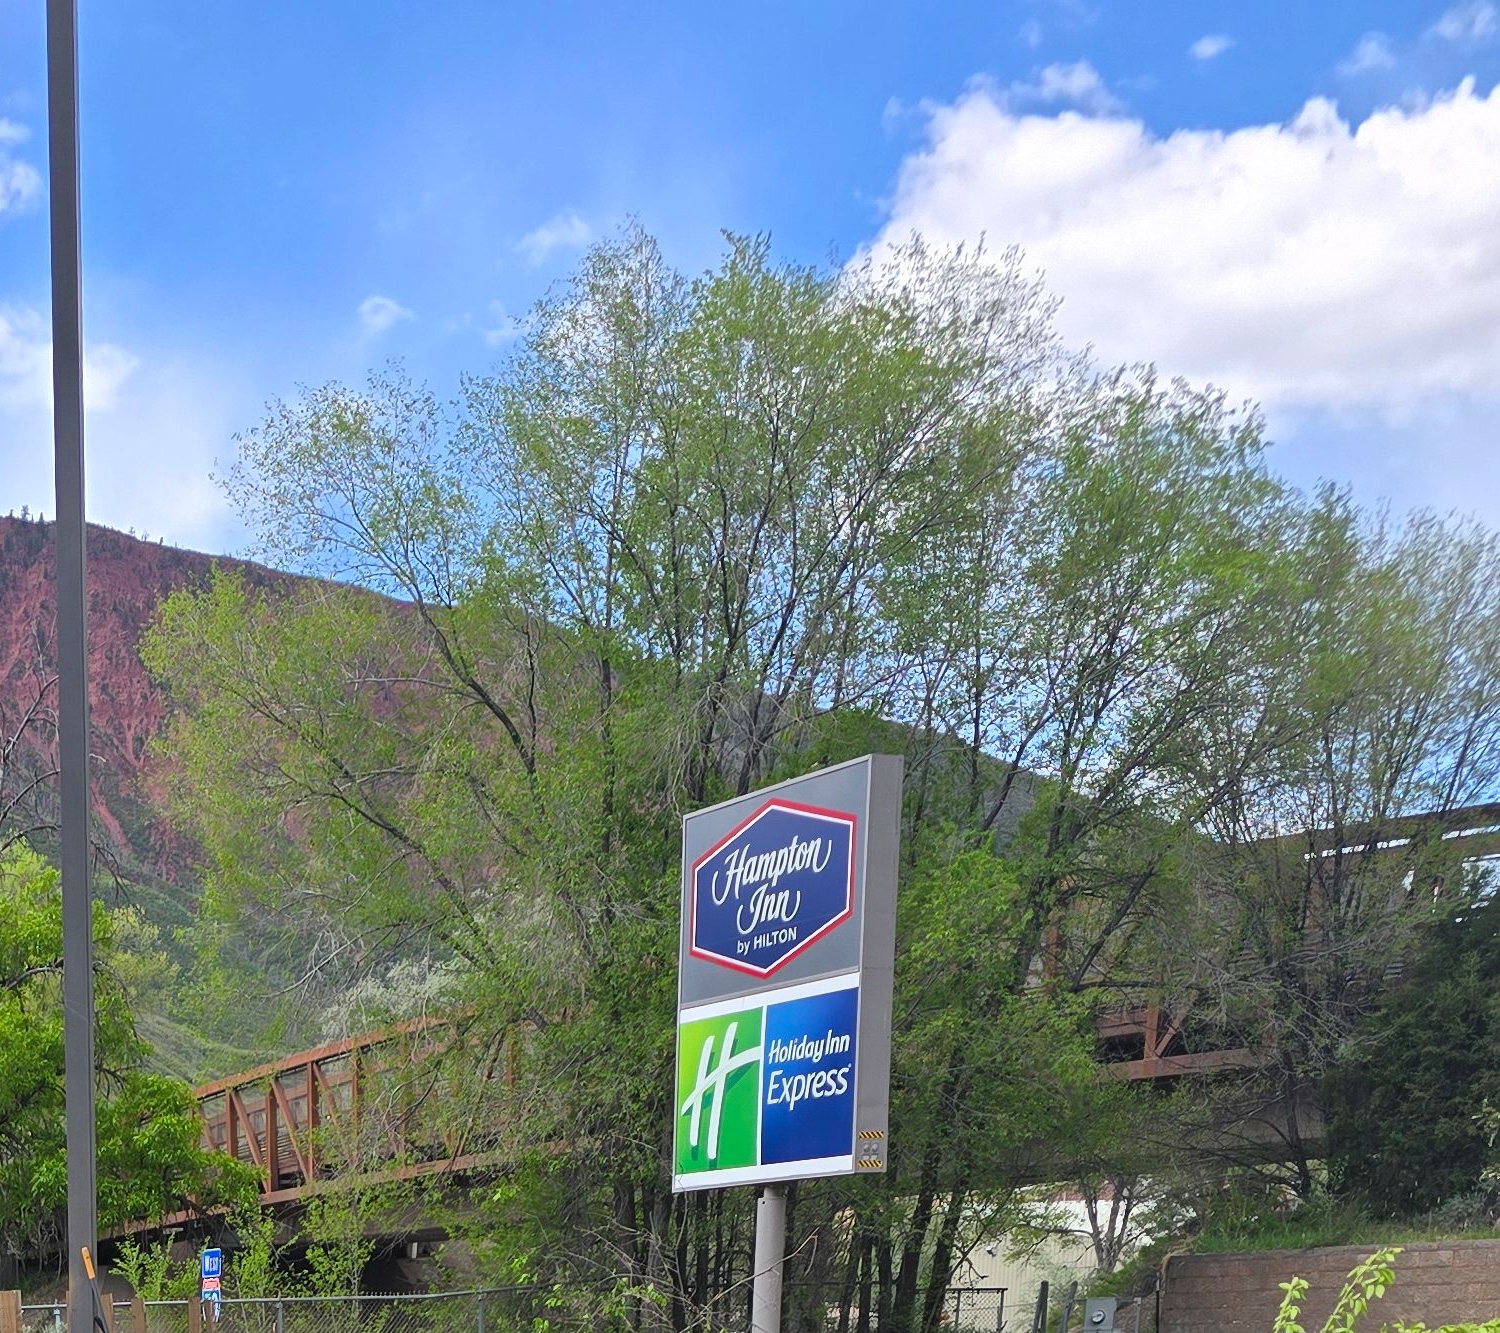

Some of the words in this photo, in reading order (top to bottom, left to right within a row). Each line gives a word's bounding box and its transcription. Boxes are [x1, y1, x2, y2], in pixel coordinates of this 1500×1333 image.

[711, 835, 833, 905] Hampton
[736, 883, 801, 935] Inn
[736, 940, 751, 956] by
[753, 926, 798, 951] HILTON
[768, 1034, 825, 1065] Holiday
[825, 1029, 851, 1056] Inn
[767, 1067, 850, 1112] Express
